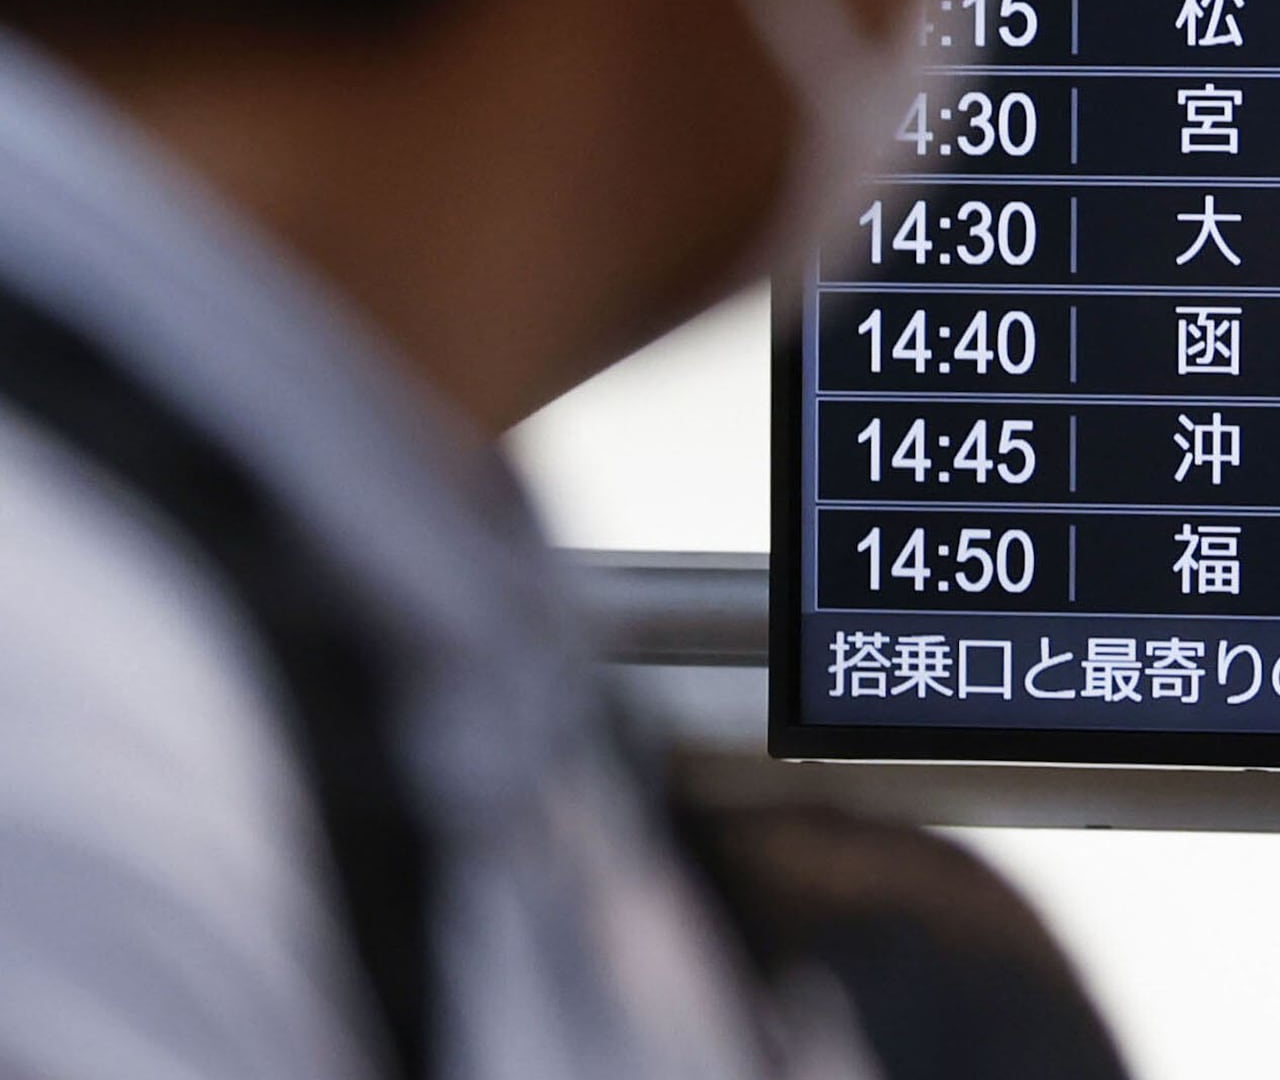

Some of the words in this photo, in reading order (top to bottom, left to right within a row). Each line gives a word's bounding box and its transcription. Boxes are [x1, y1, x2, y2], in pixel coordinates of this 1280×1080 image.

[858, 199, 1037, 266] 14:30
[857, 309, 1036, 375] 14:40
[856, 418, 1037, 485] 14:45
[855, 526, 1036, 594] 14:50
